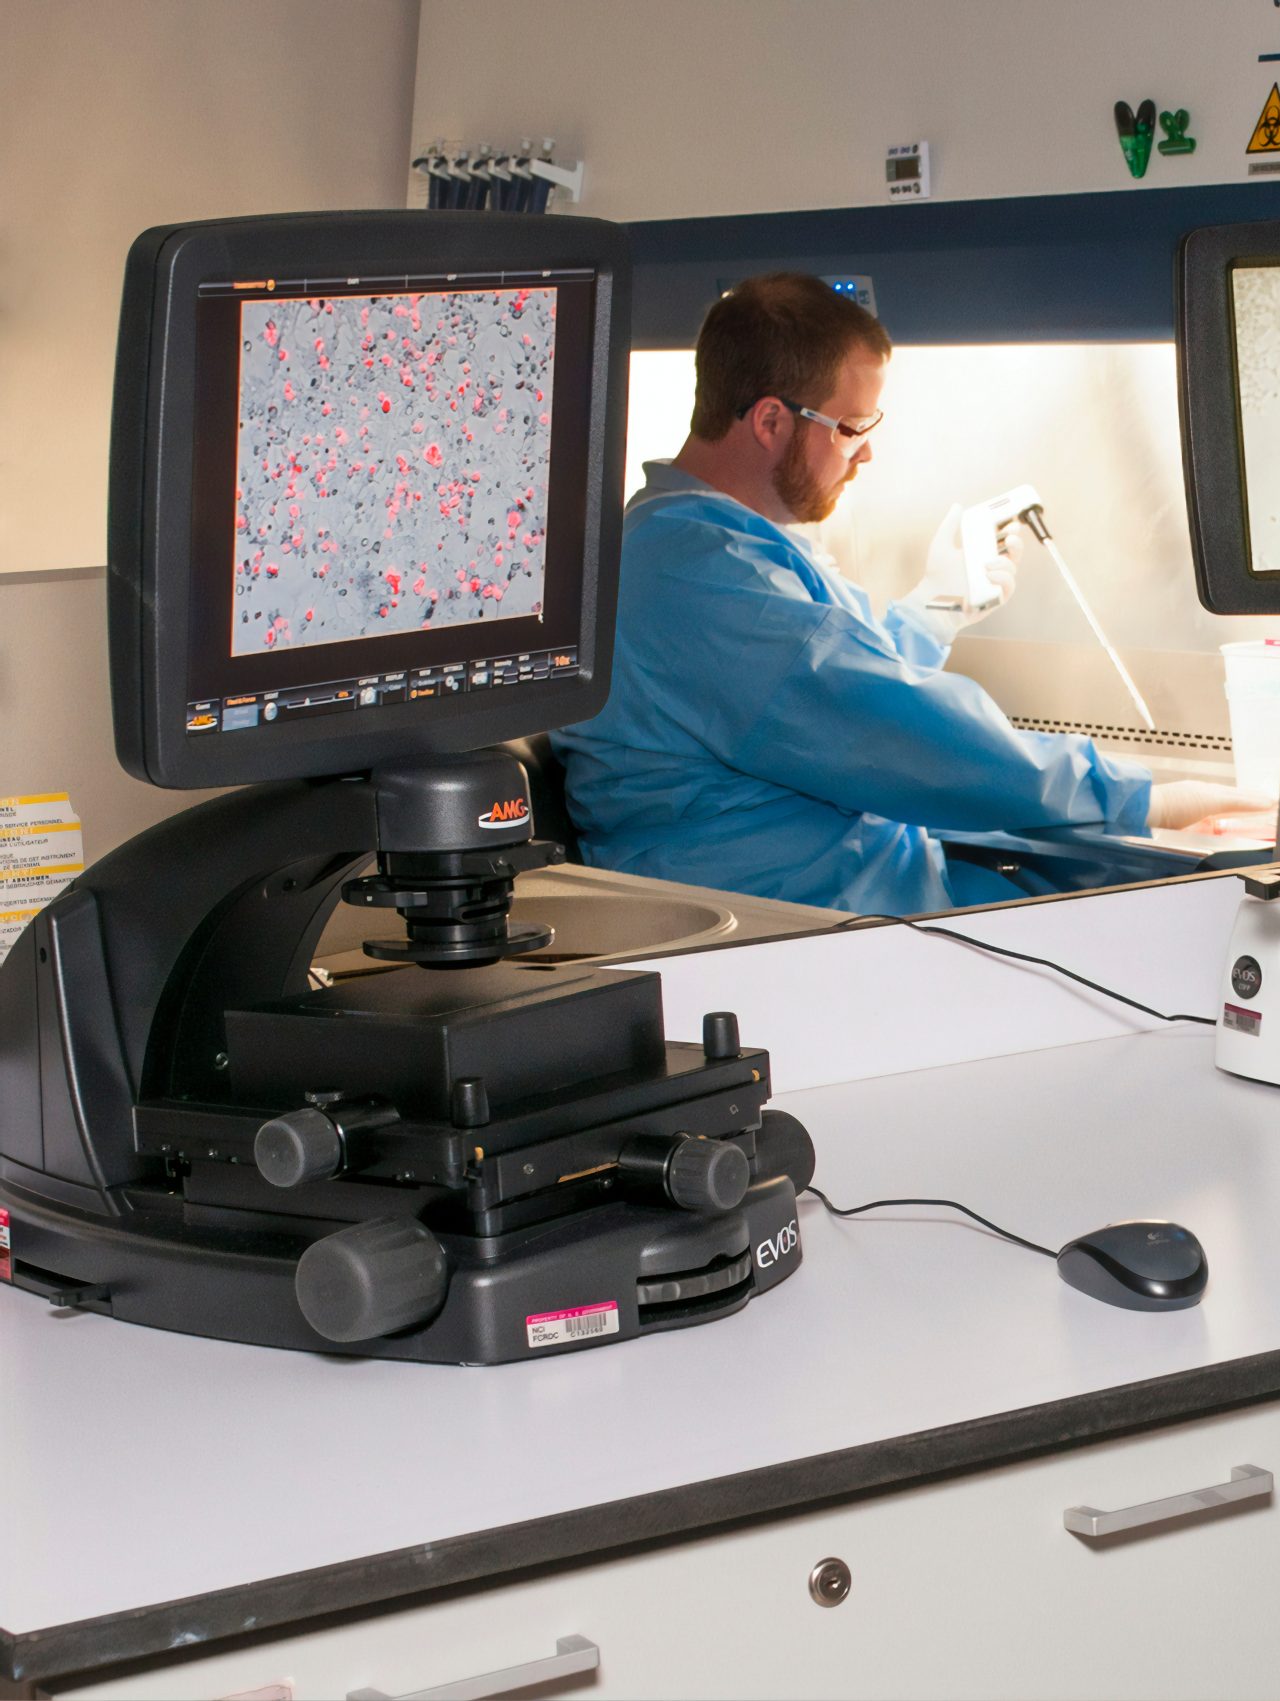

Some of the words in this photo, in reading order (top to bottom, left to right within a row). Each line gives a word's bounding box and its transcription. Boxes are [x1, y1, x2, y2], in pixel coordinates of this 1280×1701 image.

[489, 798, 526, 823] AMG
[756, 1219, 797, 1268] EVOS
[532, 1326, 546, 1334] NCI
